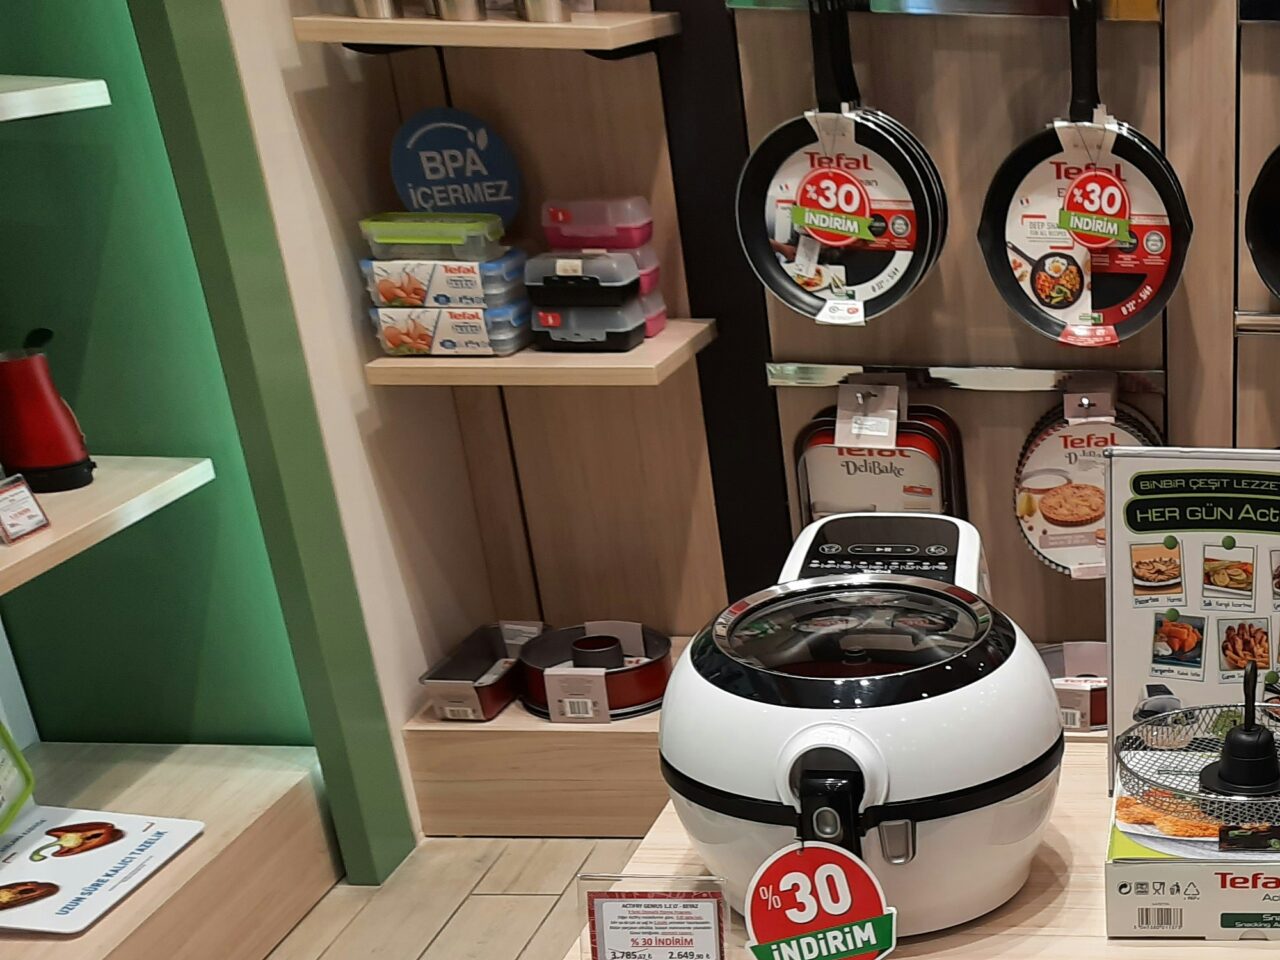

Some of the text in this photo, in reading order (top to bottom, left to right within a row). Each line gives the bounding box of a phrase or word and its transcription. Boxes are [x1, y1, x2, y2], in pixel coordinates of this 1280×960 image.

[419, 148, 488, 180] BPA
[804, 152, 873, 170] Tefal
[407, 181, 513, 212] İÇERMEZ
[805, 180, 860, 212] %30
[1073, 182, 1122, 215] %30
[804, 213, 859, 233] İNDİRİM
[1070, 213, 1118, 235] İNDİRİM
[447, 311, 482, 320] Tefal
[1059, 433, 1119, 448] Tefal
[840, 459, 905, 478] DeliBake
[1139, 479, 1185, 490] BİNBİR
[1189, 478, 1230, 490] ÇEŞİT
[1136, 507, 1180, 522] HER
[1186, 503, 1233, 520] GÜN
[55, 896, 87, 916] UZUN
[80, 879, 110, 896] SÜRE
[102, 856, 138, 877] KALICI
[759, 863, 852, 924] %30
[631, 936, 694, 946] % 30 İNDİRİM
